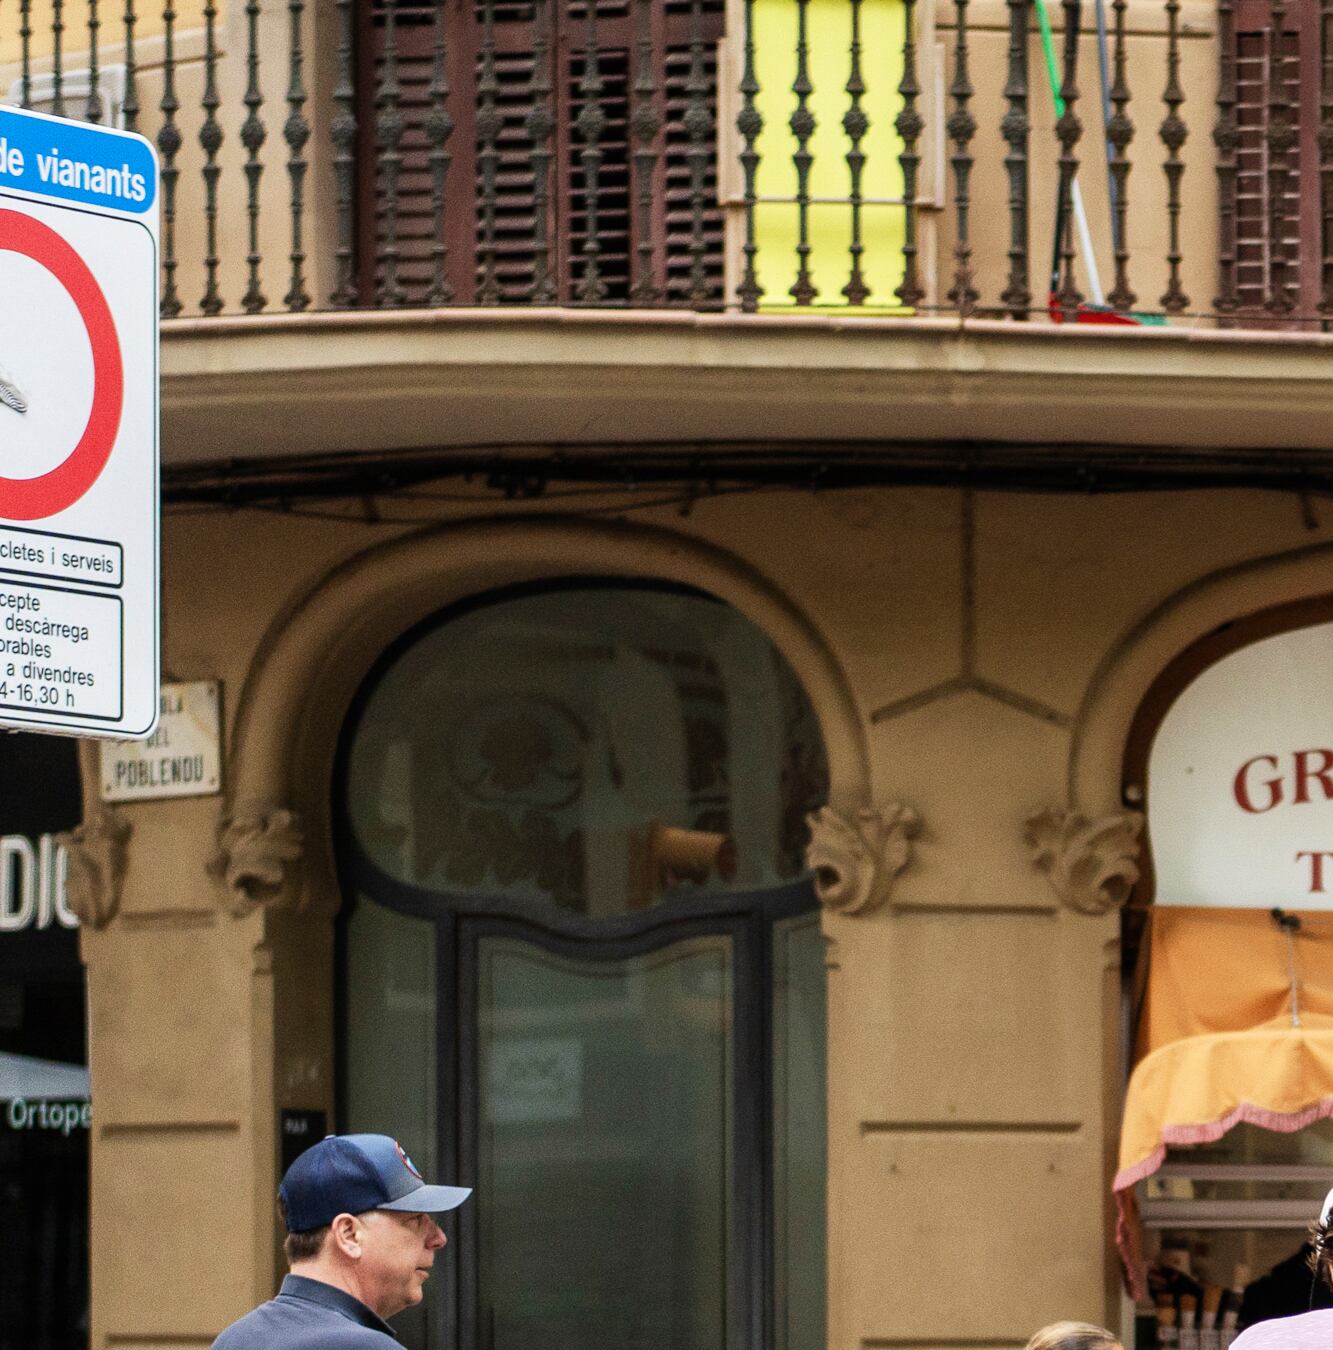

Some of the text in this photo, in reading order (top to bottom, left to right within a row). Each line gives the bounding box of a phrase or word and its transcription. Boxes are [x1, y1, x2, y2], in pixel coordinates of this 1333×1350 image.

[36, 147, 147, 202] vianants
[51, 547, 55, 565] i
[62, 552, 114, 573] serveis
[6, 613, 89, 643] descàrrega
[7, 661, 95, 687] a divendres
[66, 688, 75, 707] h
[114, 755, 204, 788] POBLENOU
